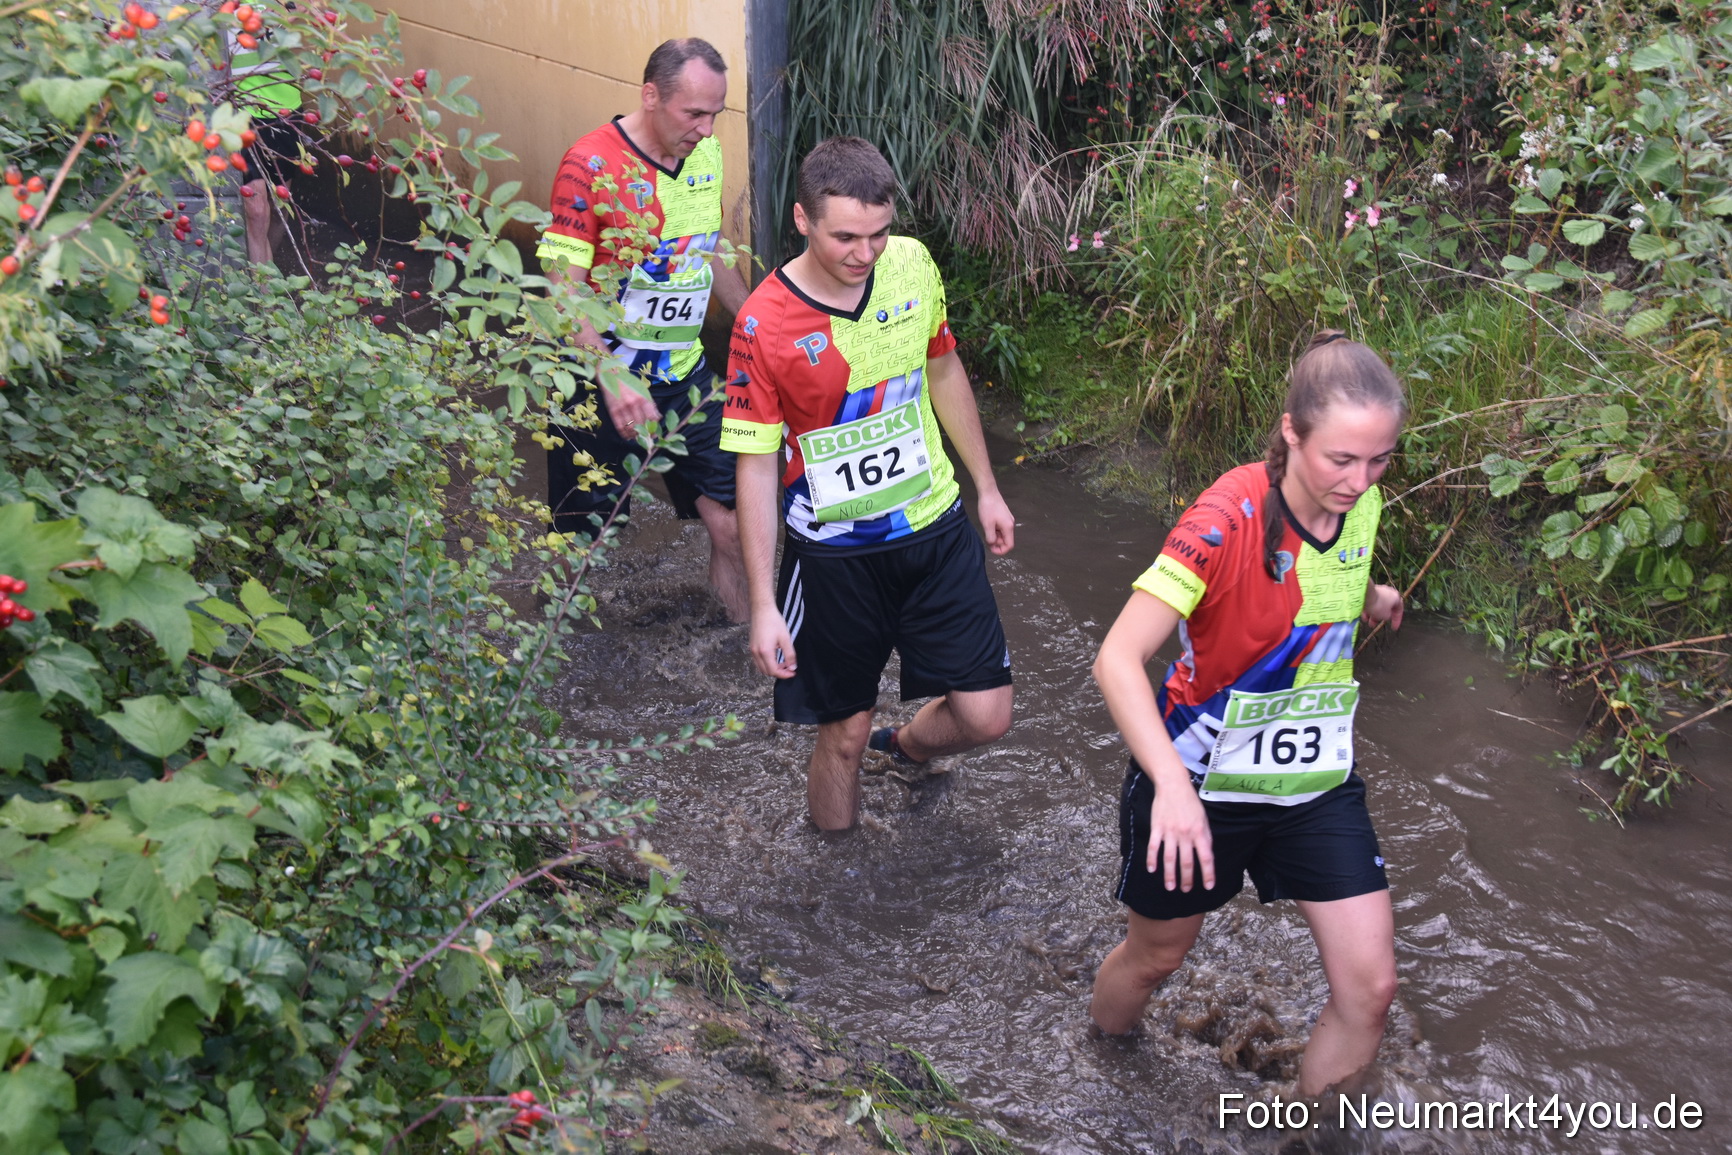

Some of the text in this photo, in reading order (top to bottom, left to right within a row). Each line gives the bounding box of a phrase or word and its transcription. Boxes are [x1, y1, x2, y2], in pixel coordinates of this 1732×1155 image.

[646, 296, 692, 322] 164
[810, 408, 909, 458] BOCK
[835, 446, 906, 492] 162
[839, 499, 874, 520] NICO
[1158, 564, 1198, 594] Motorspor
[1240, 690, 1342, 721] BOCK
[1248, 725, 1322, 765] 163
[1218, 777, 1284, 791] LAURA
